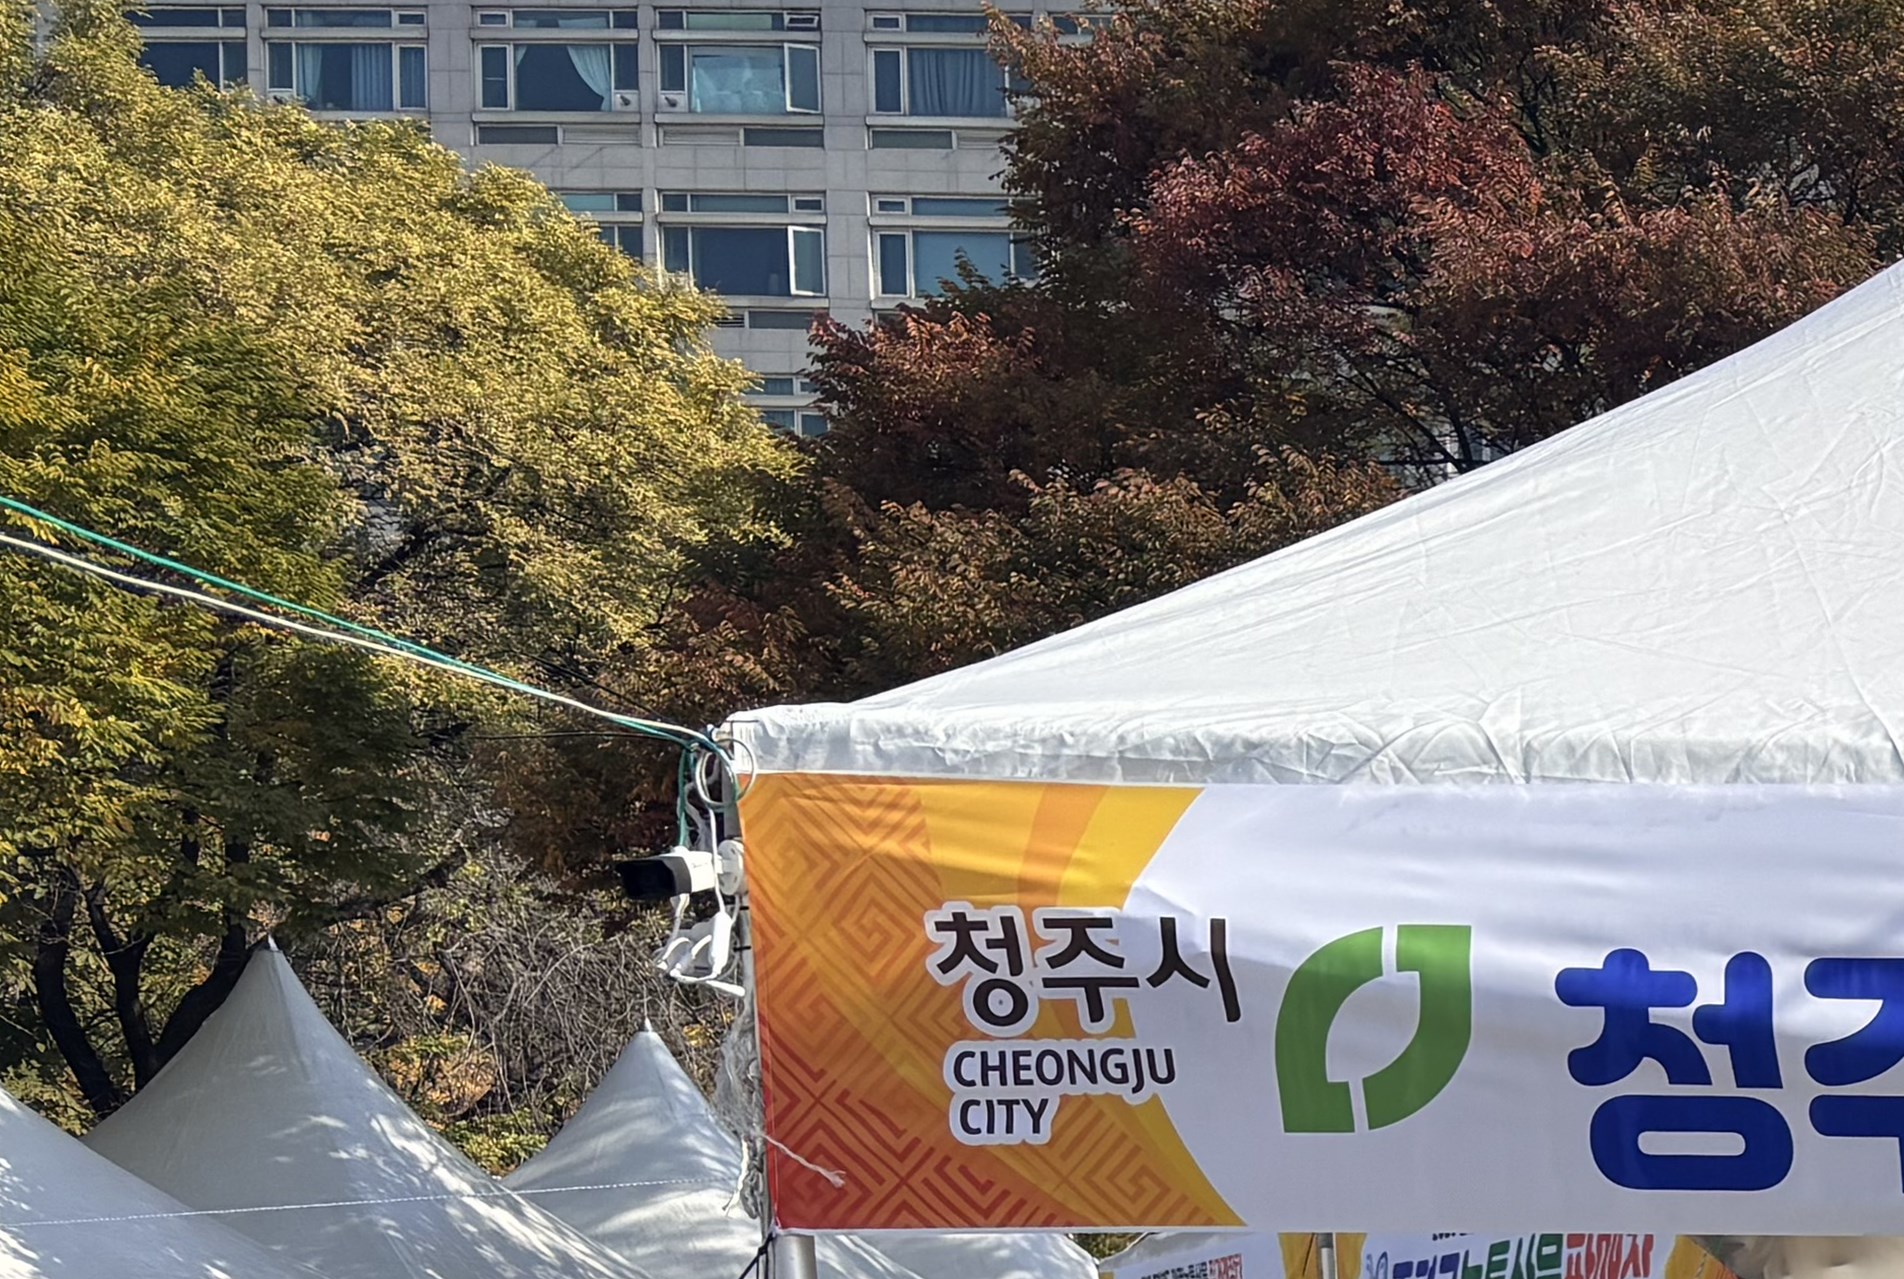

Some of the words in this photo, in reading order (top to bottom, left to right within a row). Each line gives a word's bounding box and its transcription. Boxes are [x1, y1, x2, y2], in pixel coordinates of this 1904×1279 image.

[932, 912, 1242, 1024] 청주시
[952, 1045, 1176, 1092] CHEONGJU
[957, 1095, 1052, 1138] CITY
